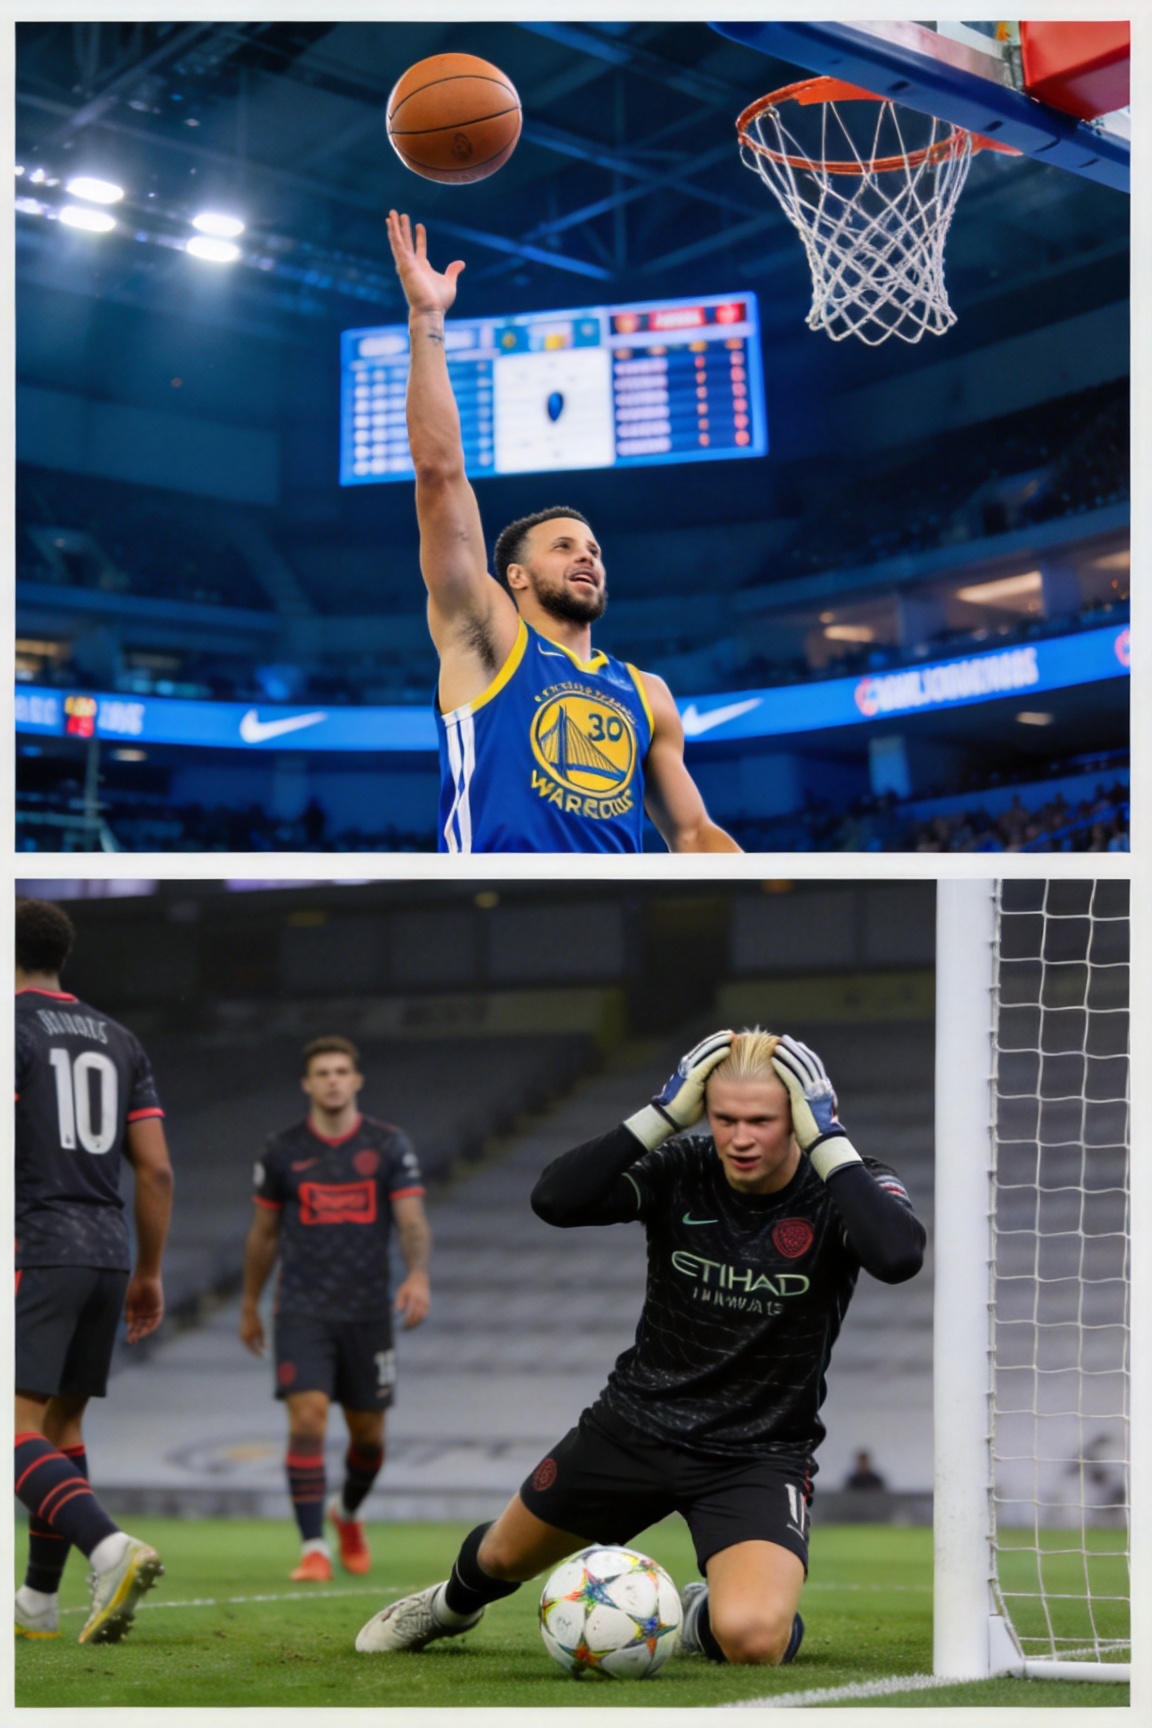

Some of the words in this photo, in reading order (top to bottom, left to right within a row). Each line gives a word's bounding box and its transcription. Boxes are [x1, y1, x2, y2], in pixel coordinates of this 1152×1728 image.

[587, 713, 623, 742] 30
[49, 1048, 118, 1155] 10
[671, 1251, 810, 1296] ETIHAD
